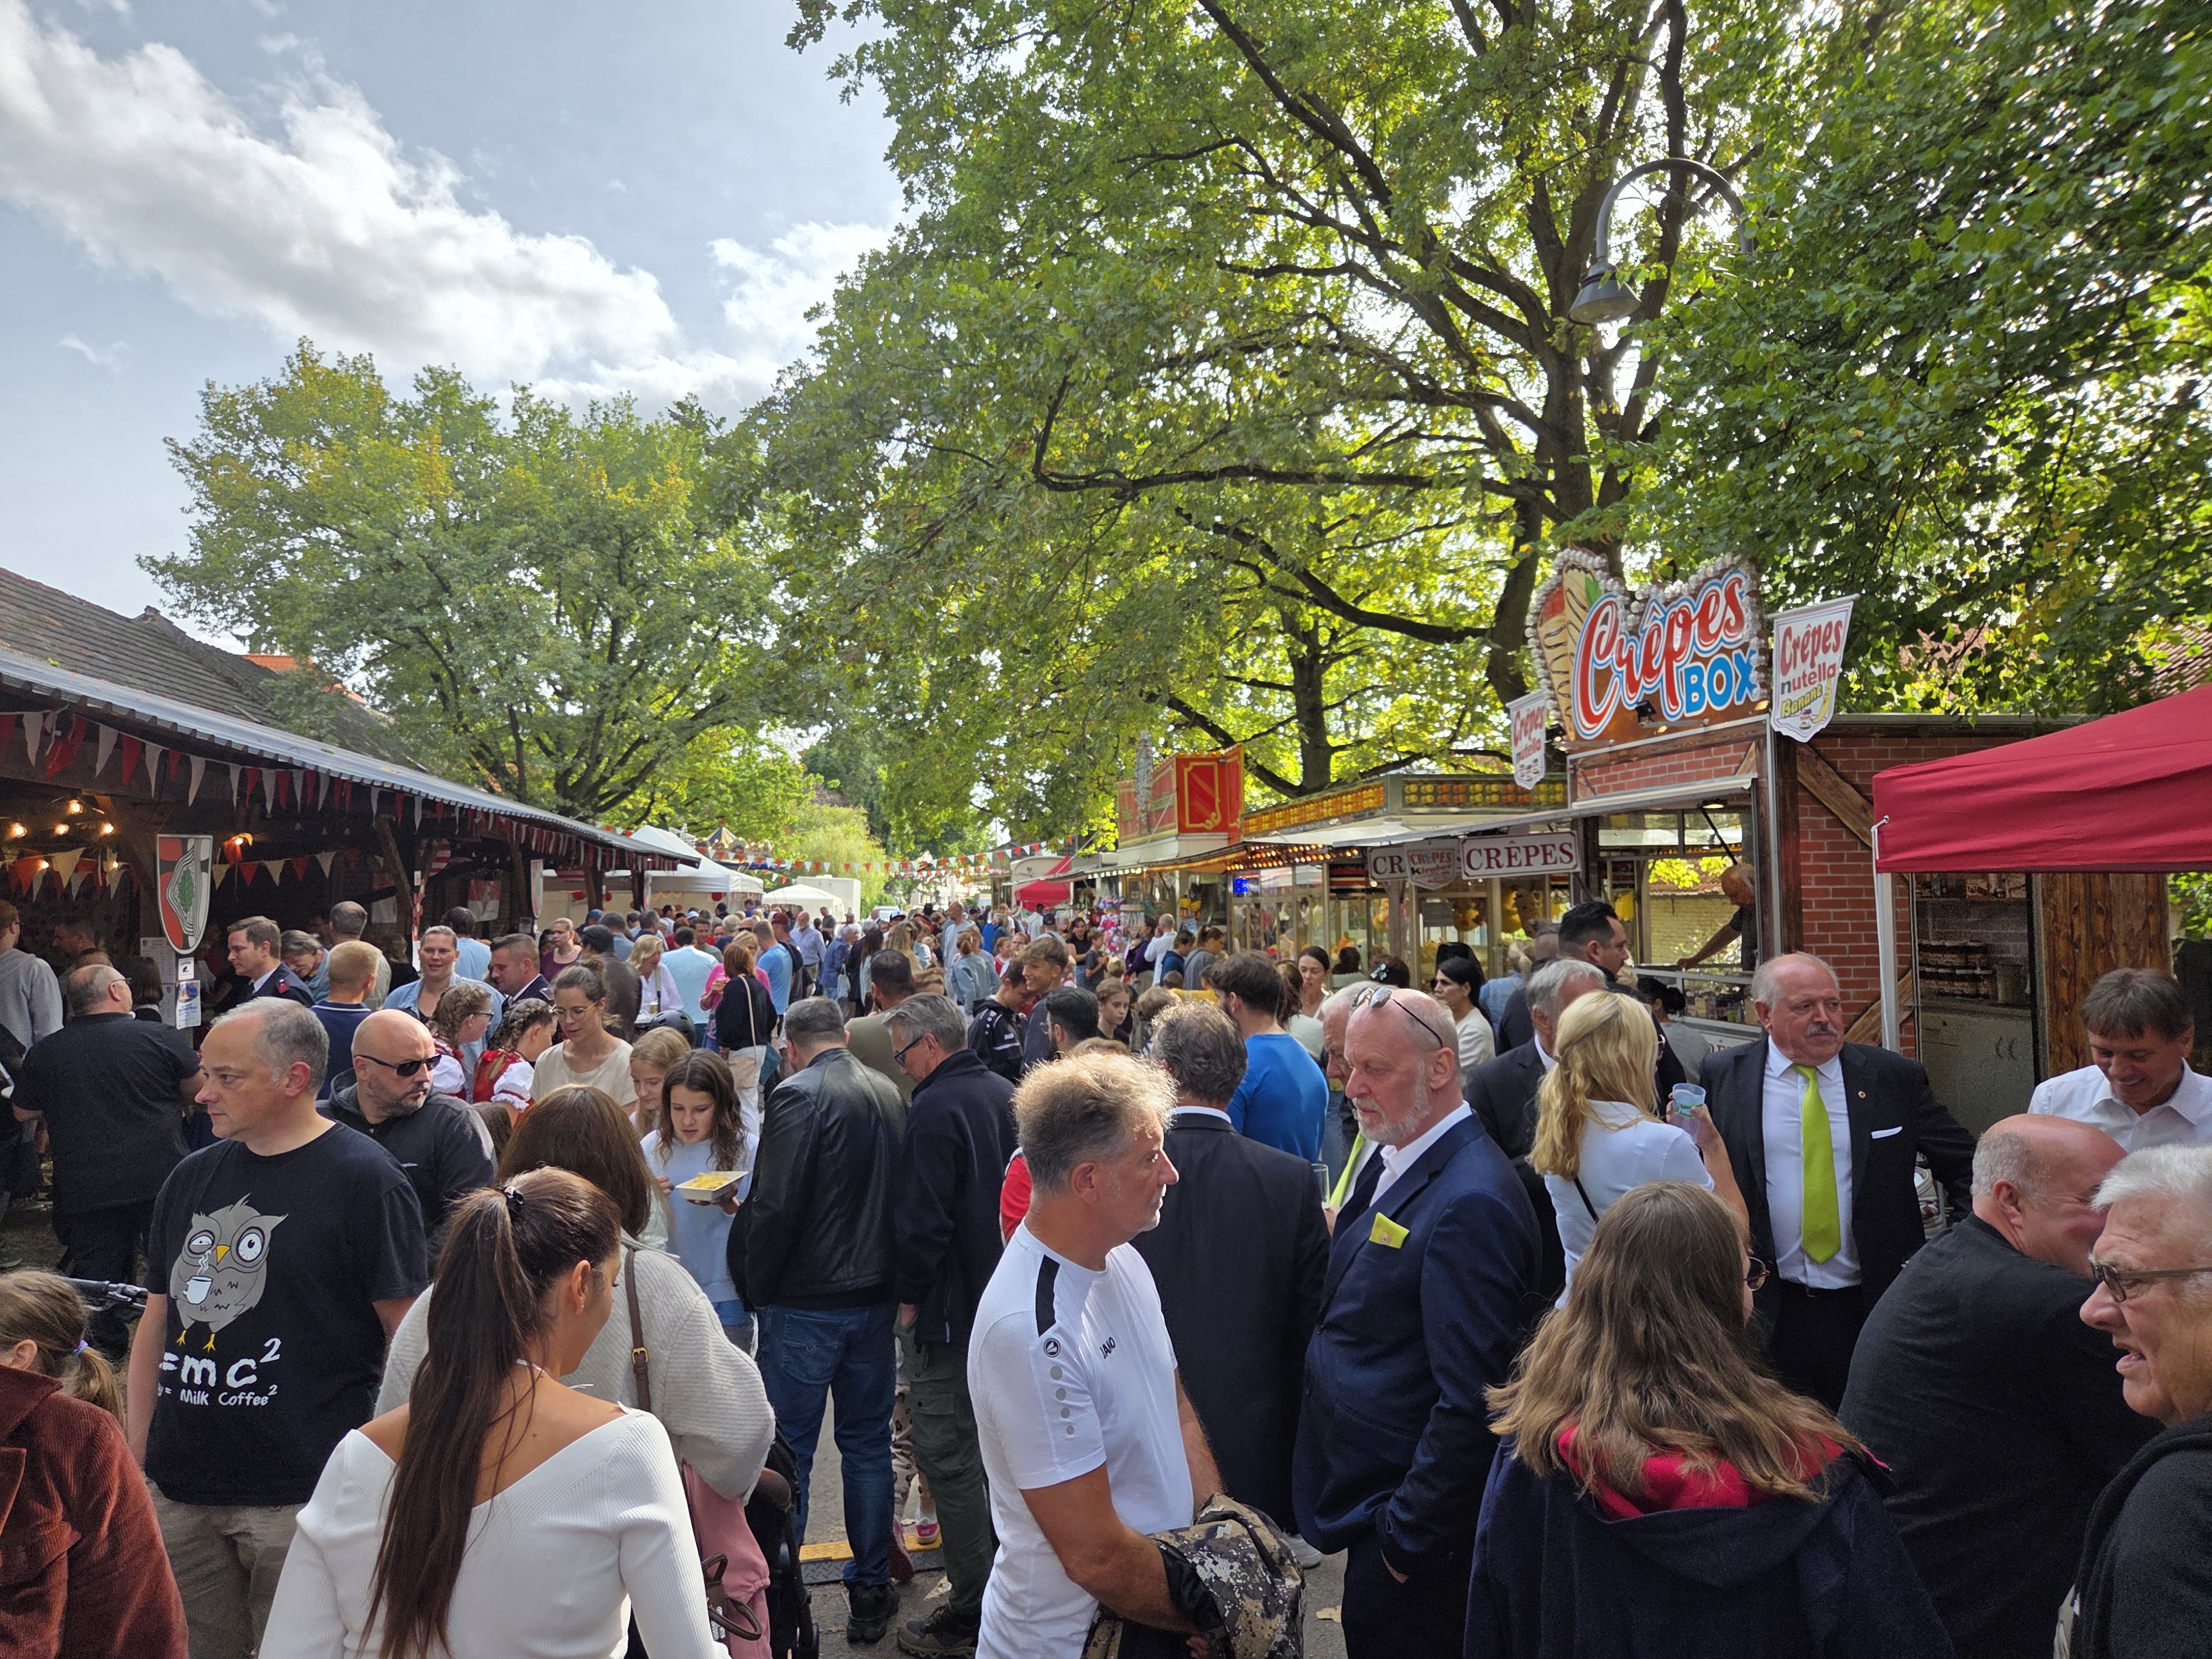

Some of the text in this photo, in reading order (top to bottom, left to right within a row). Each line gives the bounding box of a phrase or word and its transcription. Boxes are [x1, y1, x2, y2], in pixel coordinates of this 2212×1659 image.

[1575, 573, 1747, 731] Crêpes
[1780, 619, 1843, 677] Crêpes
[1683, 649, 1756, 714] BOX
[1781, 662, 1837, 695] nutella
[1780, 684, 1823, 718] Banane
[1513, 706, 1545, 747] Crêpes
[1516, 738, 1541, 764] nutella
[1466, 840, 1574, 870] CRÊPES
[180, 1389, 209, 1405] Milk
